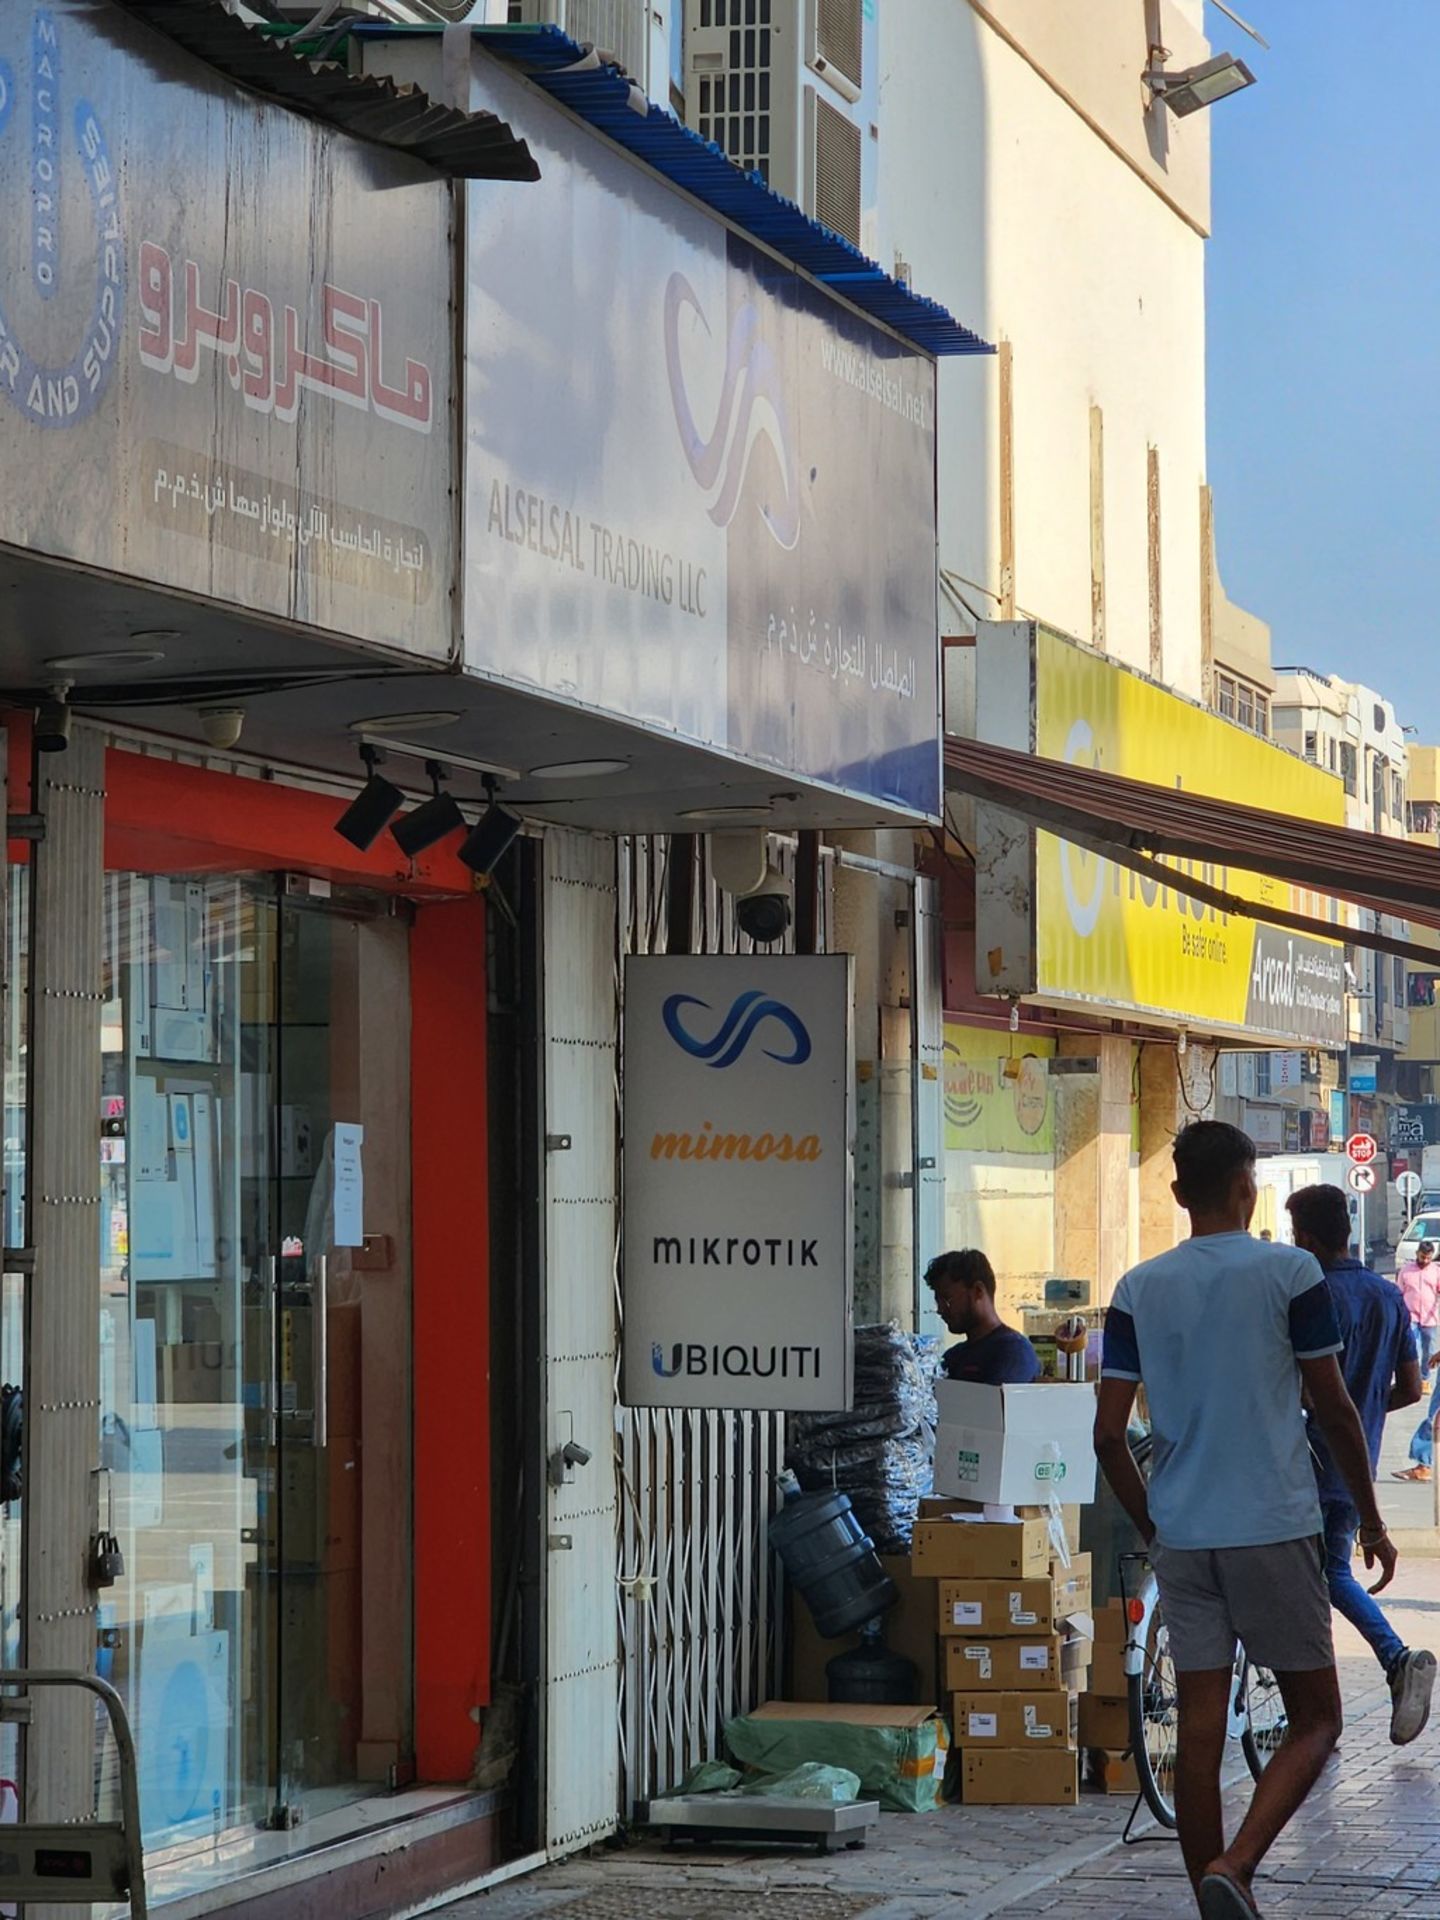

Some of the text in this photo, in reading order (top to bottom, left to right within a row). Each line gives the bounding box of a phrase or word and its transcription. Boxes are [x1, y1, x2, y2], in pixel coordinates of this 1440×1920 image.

[37, 19, 56, 286] MACROPRO
[27, 373, 80, 417] AND
[82, 117, 121, 393] SUPPLIES
[139, 240, 432, 434] ماكروبرو
[821, 337, 925, 429] www.alselsal.net
[331, 524, 381, 562] الحاسب
[384, 538, 425, 573] لتجارة
[488, 478, 707, 618] ALSELSAL TRADING LLC
[824, 622, 866, 687] للتجارة
[650, 1121, 823, 1162] mimosa
[1351, 1148, 1372, 1158] STOP
[652, 1342, 820, 1378] UBIQUITI
